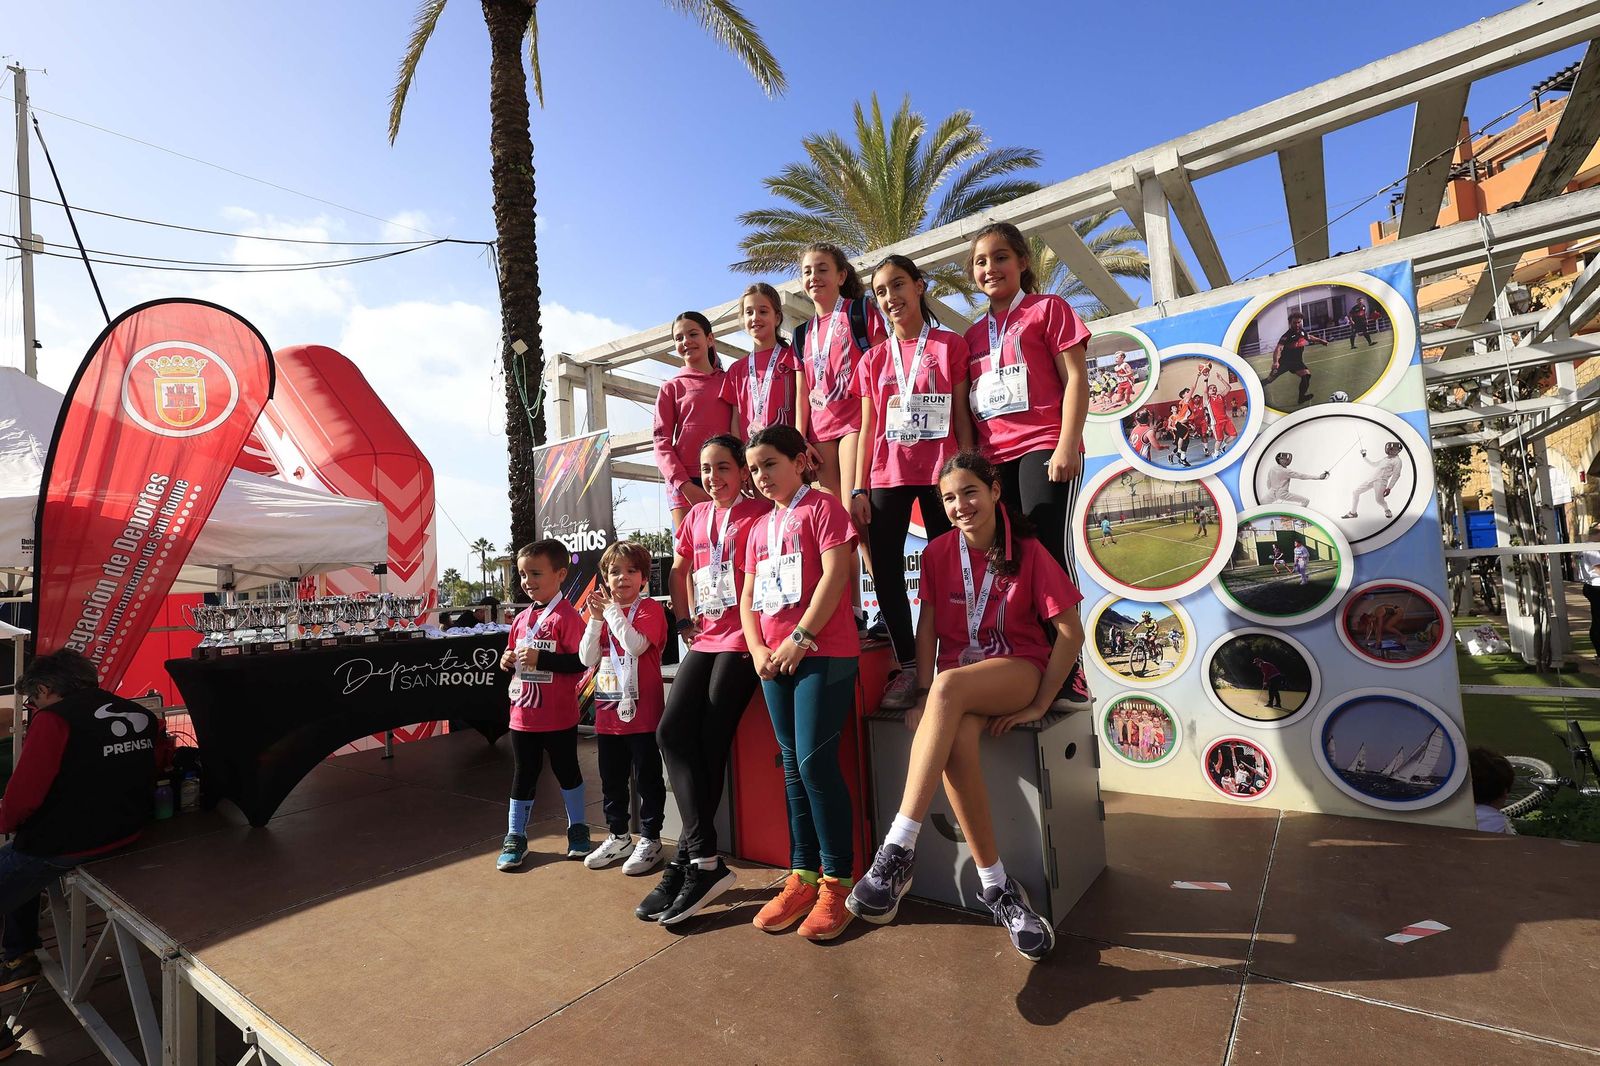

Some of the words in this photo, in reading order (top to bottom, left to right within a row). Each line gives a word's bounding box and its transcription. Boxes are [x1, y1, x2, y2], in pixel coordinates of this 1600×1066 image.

[812, 398, 823, 406] RUN
[989, 394, 1005, 404] RUN
[160, 478, 189, 518] Roque
[112, 472, 170, 552] Deportes
[149, 516, 170, 540] San
[543, 524, 607, 553] safíos
[142, 541, 158, 558] de
[780, 556, 795, 565] UN
[102, 553, 130, 578] de
[98, 559, 149, 644] Ayuntamiento
[706, 607, 720, 615] RUN
[65, 578, 119, 653] egación
[334, 649, 475, 694] Deportes
[103, 738, 153, 756] PRENSA
